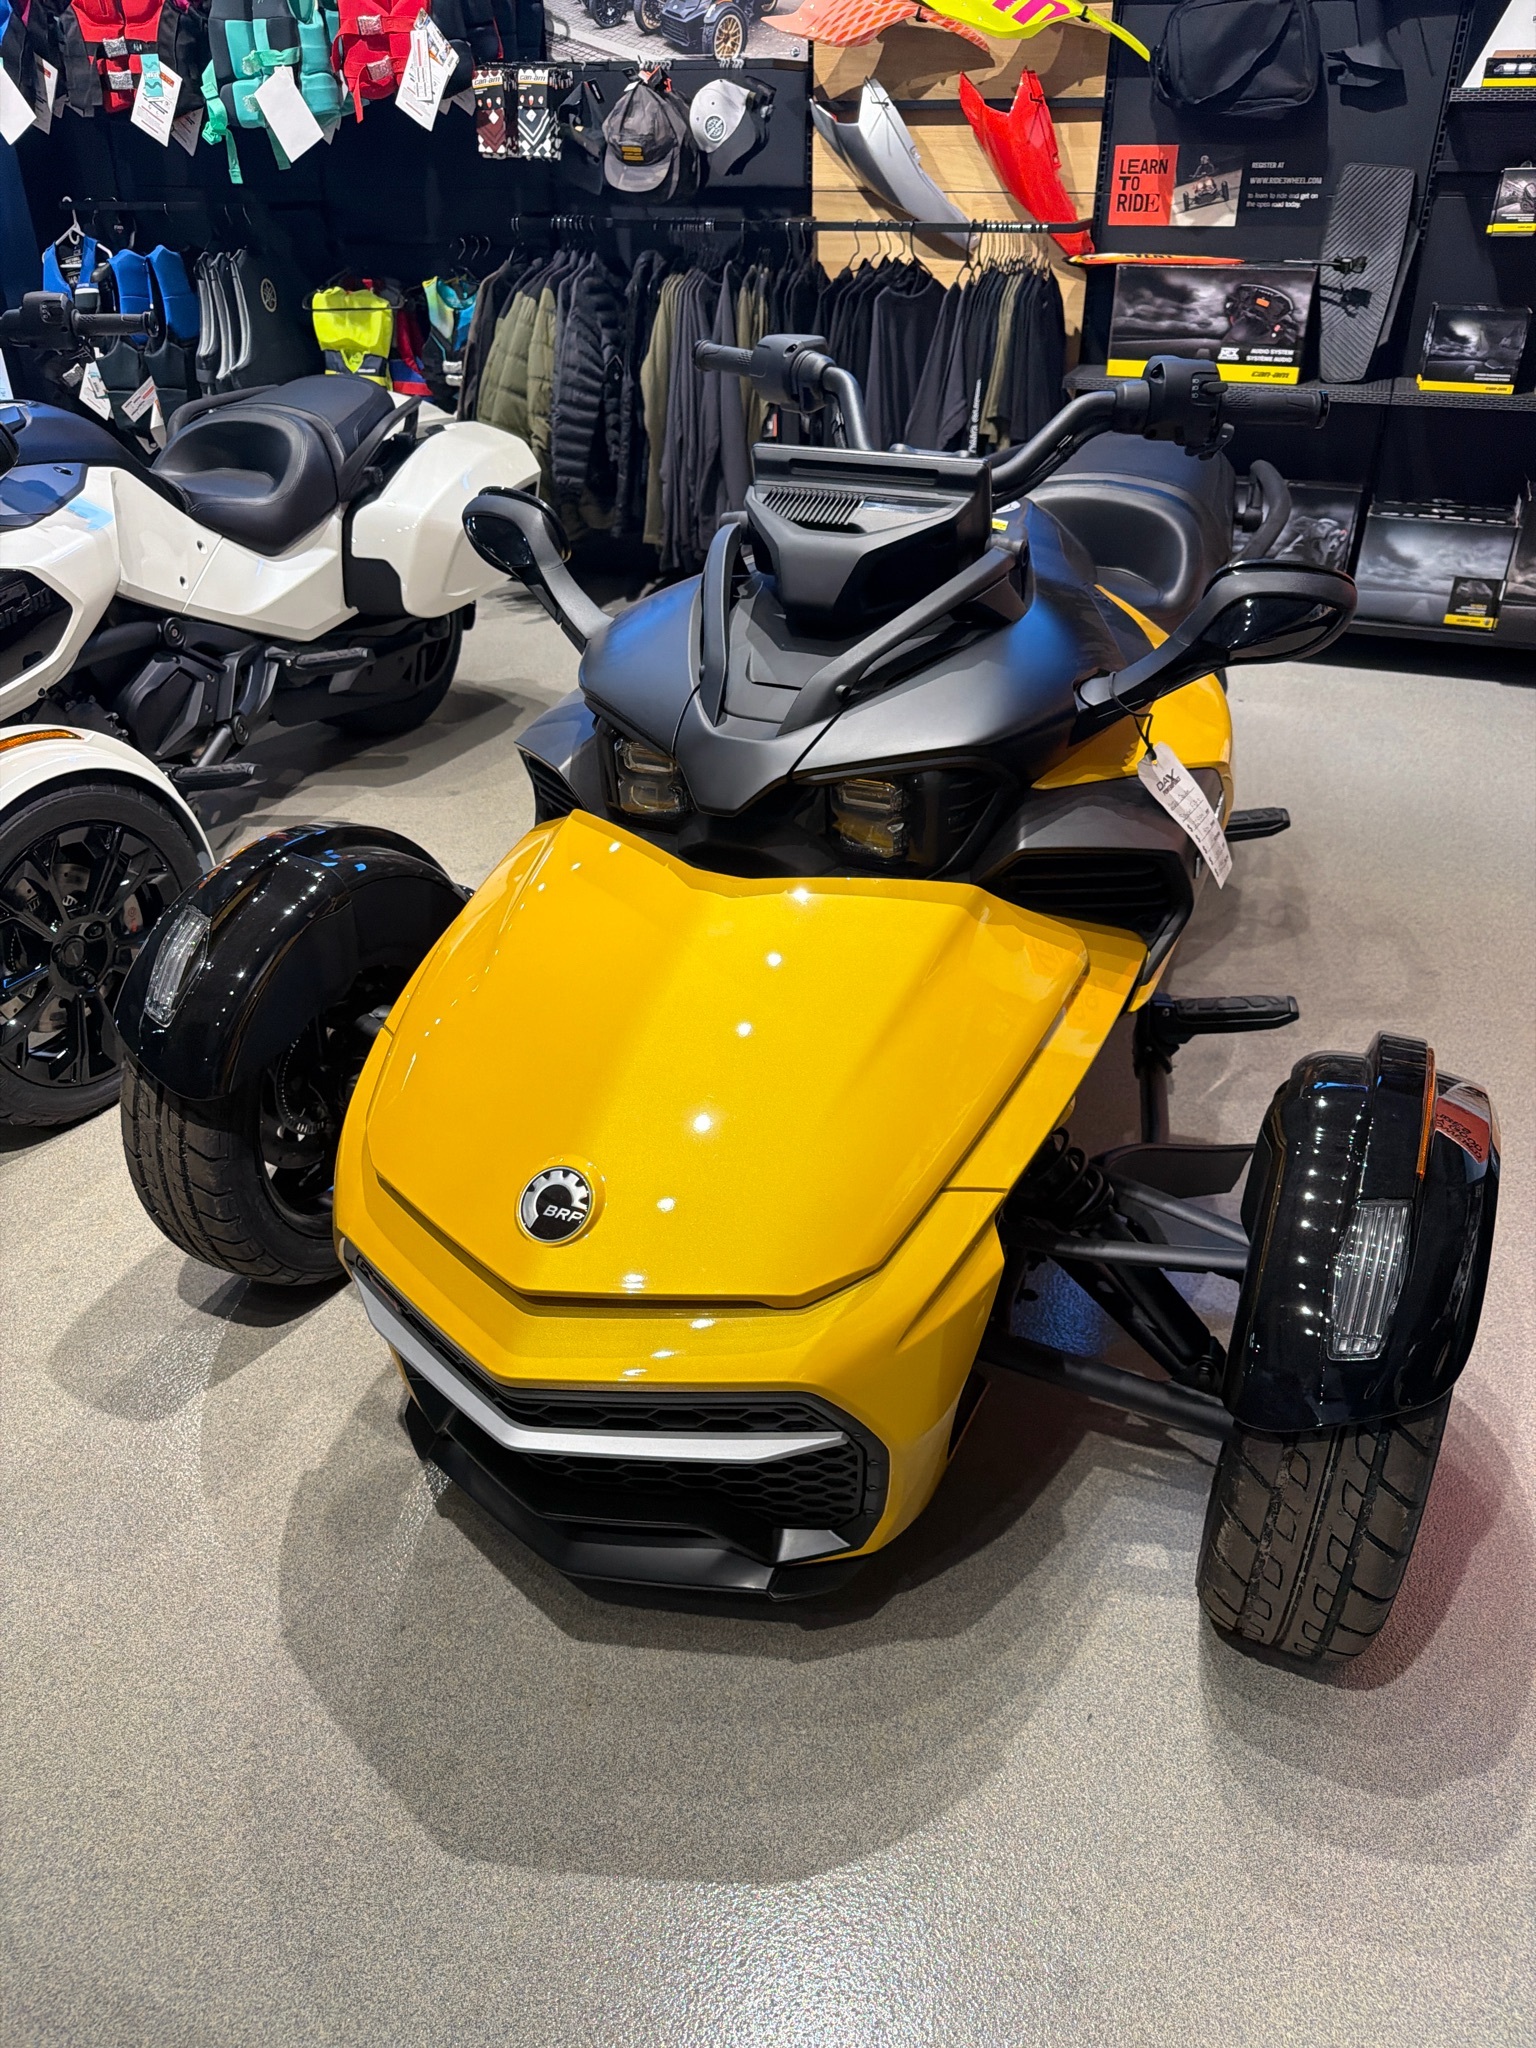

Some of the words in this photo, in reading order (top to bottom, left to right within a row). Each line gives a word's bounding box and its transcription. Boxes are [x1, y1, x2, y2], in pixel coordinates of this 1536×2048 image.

[474, 77, 501, 86] can-am
[1120, 158, 1169, 175] LEARN
[1118, 176, 1140, 191] TO
[1116, 193, 1160, 213] RIDE
[1300, 193, 1310, 201] get
[1250, 371, 1290, 379] can-am
[1156, 768, 1174, 792] DAX
[542, 1204, 586, 1223] BRP
